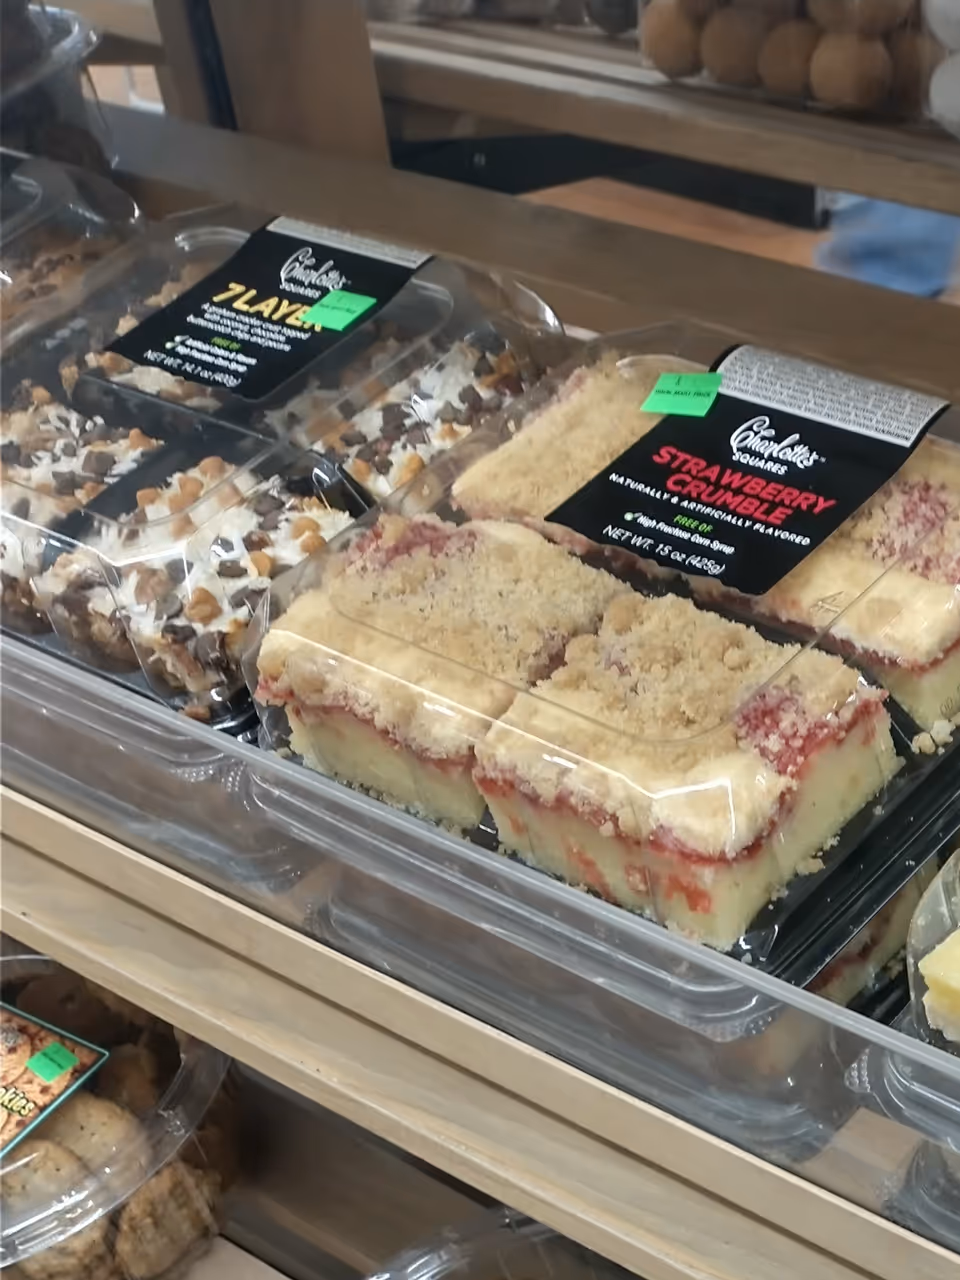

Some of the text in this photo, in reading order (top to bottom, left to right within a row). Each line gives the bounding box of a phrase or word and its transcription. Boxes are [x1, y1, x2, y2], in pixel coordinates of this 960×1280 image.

[730, 415, 819, 469] Charlotte's
[732, 450, 788, 475] SQUARES
[652, 445, 837, 516] STRAWBERRY
[666, 473, 794, 525] CRUMBLE
[609, 472, 670, 500] NATURALLY
[680, 499, 752, 528] ARTIFICIALLY
[753, 522, 811, 546] FLAVORED
[636, 514, 735, 555] High Fructose Corn Syrup
[673, 514, 714, 533] FREE OF
[602, 524, 633, 542] NET
[655, 543, 672, 556] 15
[670, 550, 687, 562] oz
[686, 553, 726, 576] (425g)
